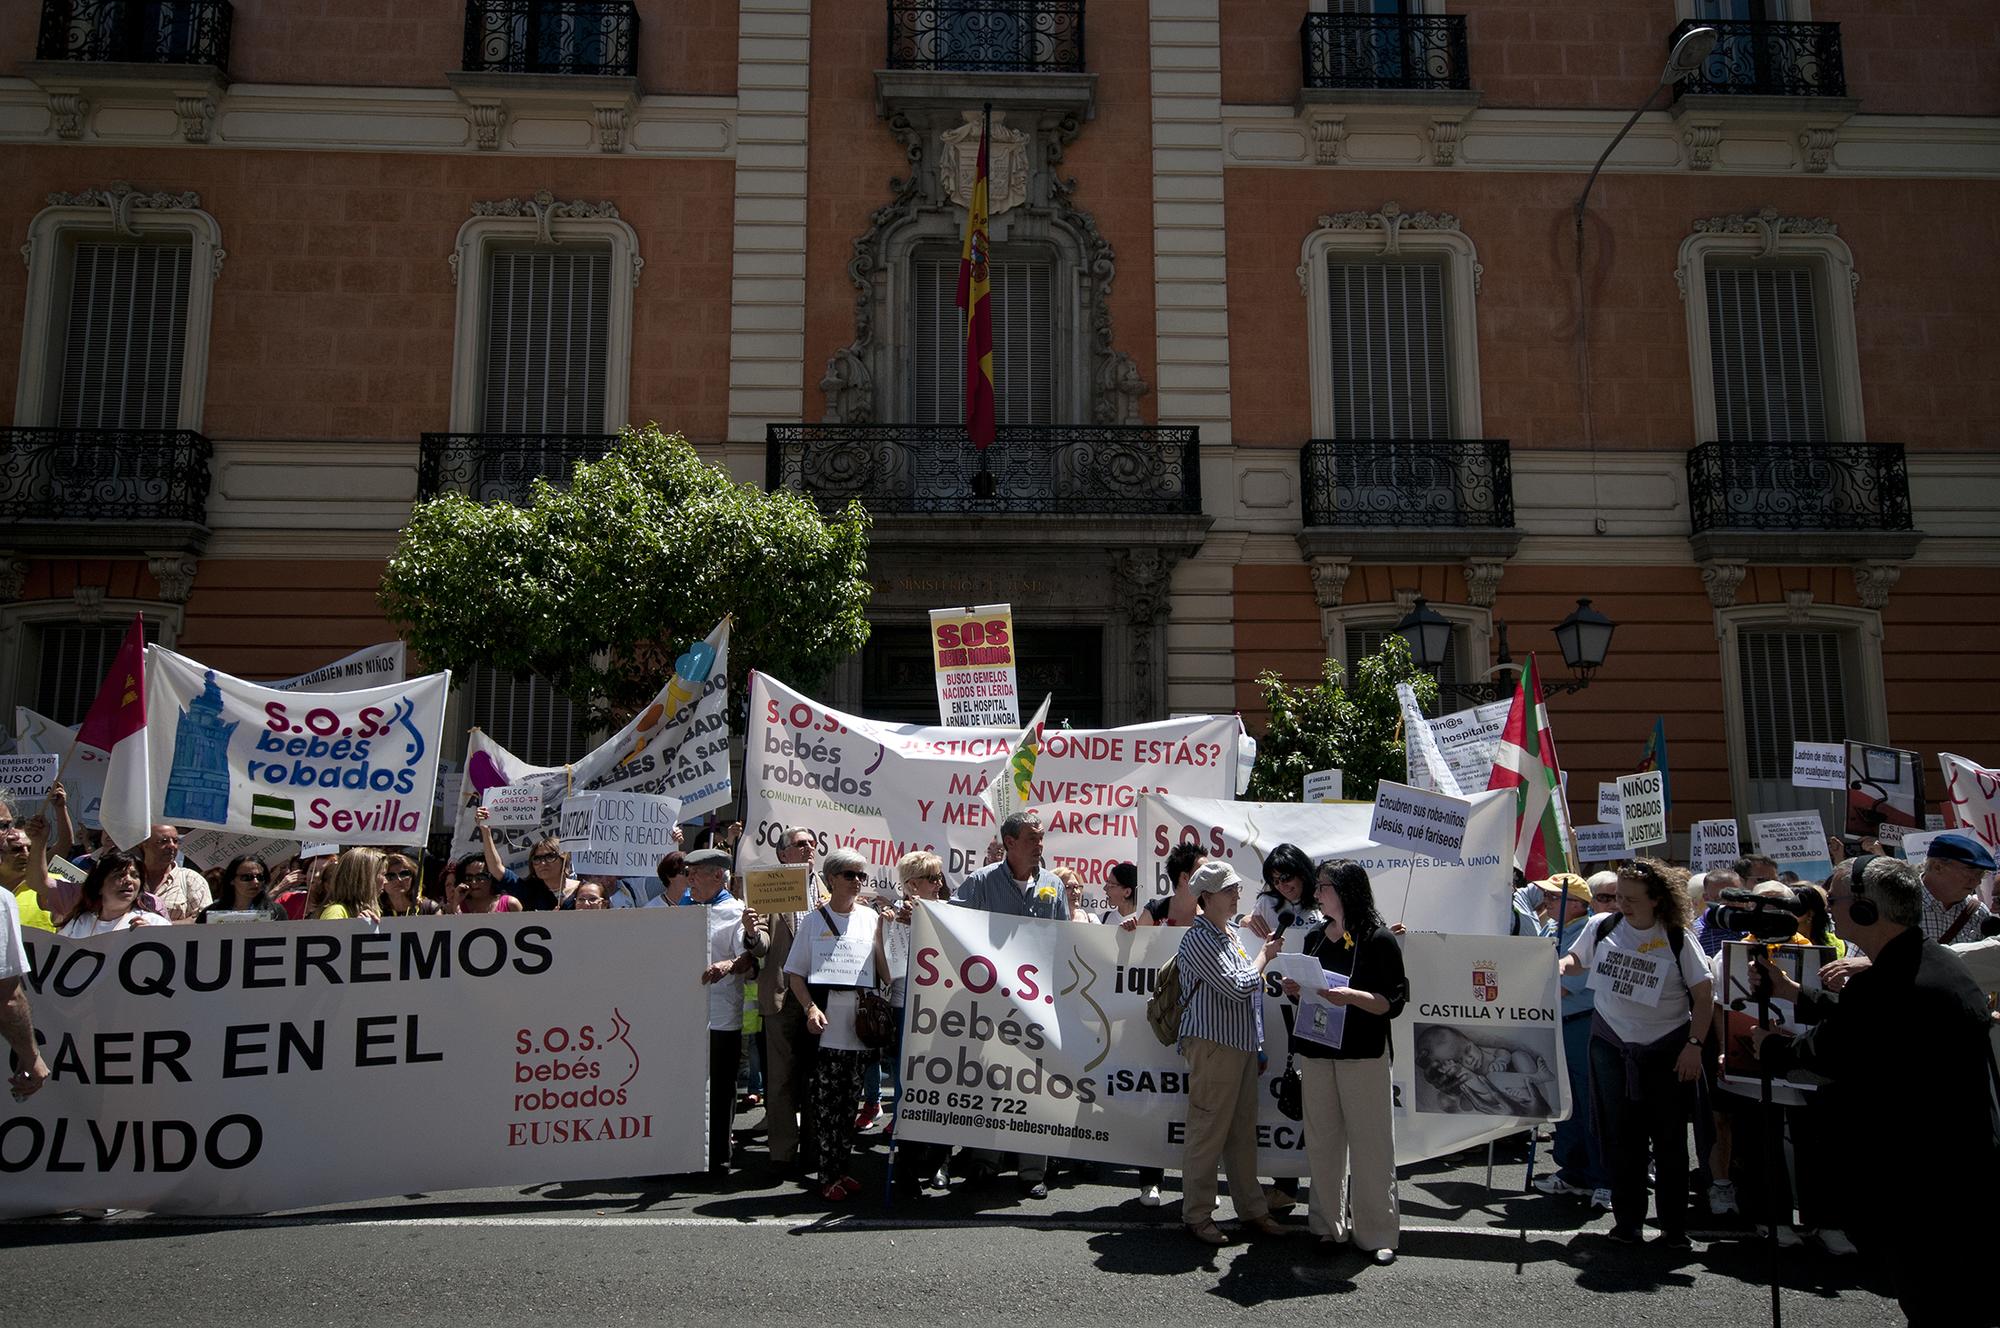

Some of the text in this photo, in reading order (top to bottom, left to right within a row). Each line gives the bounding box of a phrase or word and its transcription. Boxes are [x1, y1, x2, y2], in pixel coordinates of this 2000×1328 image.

[936, 620, 1009, 649] SOS
[300, 655, 395, 686] TAMBIÉN MIS NIÑOS
[946, 671, 1007, 686] BUSCO GEMELOS
[942, 686, 975, 700] NACIDOS
[977, 686, 987, 697] EN
[766, 699, 848, 735] S.O.S.
[952, 699, 1007, 713] EN EL HOSPITAL
[264, 701, 391, 738] S.O.S.
[946, 713, 1016, 727] ARNAU DE VILANOBA
[1441, 722, 1500, 744] hospitales
[254, 729, 372, 762] bebés
[764, 727, 842, 764] bebés
[1134, 737, 1222, 768] ESTÁS?
[1794, 750, 1814, 761] Ladrón
[1814, 752, 1821, 761] de
[11, 765, 46, 773] RAMÓN
[37, 757, 56, 765] 1967
[1794, 766, 1804, 775] con
[1805, 766, 1831, 778] cualquier
[248, 758, 417, 795] robados
[762, 760, 872, 797] robados
[1623, 778, 1660, 798] NIÑOS
[502, 788, 528, 796] BUSCO
[760, 788, 883, 816] COMUNITAT VALENCIANA
[308, 798, 420, 833] Sevilla
[643, 801, 669, 824] LOS
[917, 800, 935, 823] Y
[1379, 793, 1466, 828] Encubren sus roba-niños.
[1625, 800, 1662, 820] ROBADOS
[624, 825, 675, 846] ROBADOS
[1375, 815, 1464, 849] ¡Jesús, qué fariseos!
[1577, 831, 1591, 841] Ladrón
[1628, 822, 1663, 846] ¡JUSTICIA!
[1702, 822, 1735, 838] NIÑOS
[577, 847, 619, 866] TAMBIÉN
[626, 851, 647, 867] SON
[1578, 845, 1587, 853] con
[1704, 842, 1737, 855] ROBADOS
[1790, 850, 1822, 858] ROBADO
[949, 848, 976, 874] DE
[1376, 860, 1385, 869] A
[1386, 858, 1430, 868] TRAVÉS
[1433, 857, 1447, 868] DE
[1467, 855, 1500, 866] UNIÓN
[20, 925, 555, 998] NO QUEREMOS
[1606, 951, 1657, 975] BUSCO UN HERMANO
[914, 947, 1054, 1005] S.O.S.
[1611, 965, 1619, 978] EL
[1622, 968, 1631, 981] DE
[1629, 970, 1646, 985] JULIO
[1611, 980, 1621, 993] EN
[910, 994, 1046, 1051] bebés
[1419, 1003, 1555, 1021] CASTILLA Y LEON
[222, 1019, 326, 1080] EN
[354, 1014, 445, 1068] EL
[515, 1024, 603, 1055] S.O.S.
[515, 1054, 600, 1084] bebés
[906, 1046, 1097, 1104] robados
[514, 1083, 627, 1112] robados
[904, 1088, 1028, 1115] 608 652 722
[507, 1114, 654, 1147] EUSKADI
[901, 1108, 1110, 1142] castillayleon@sos-bebesrobados.es
[0, 1113, 263, 1174] OLVIDO
